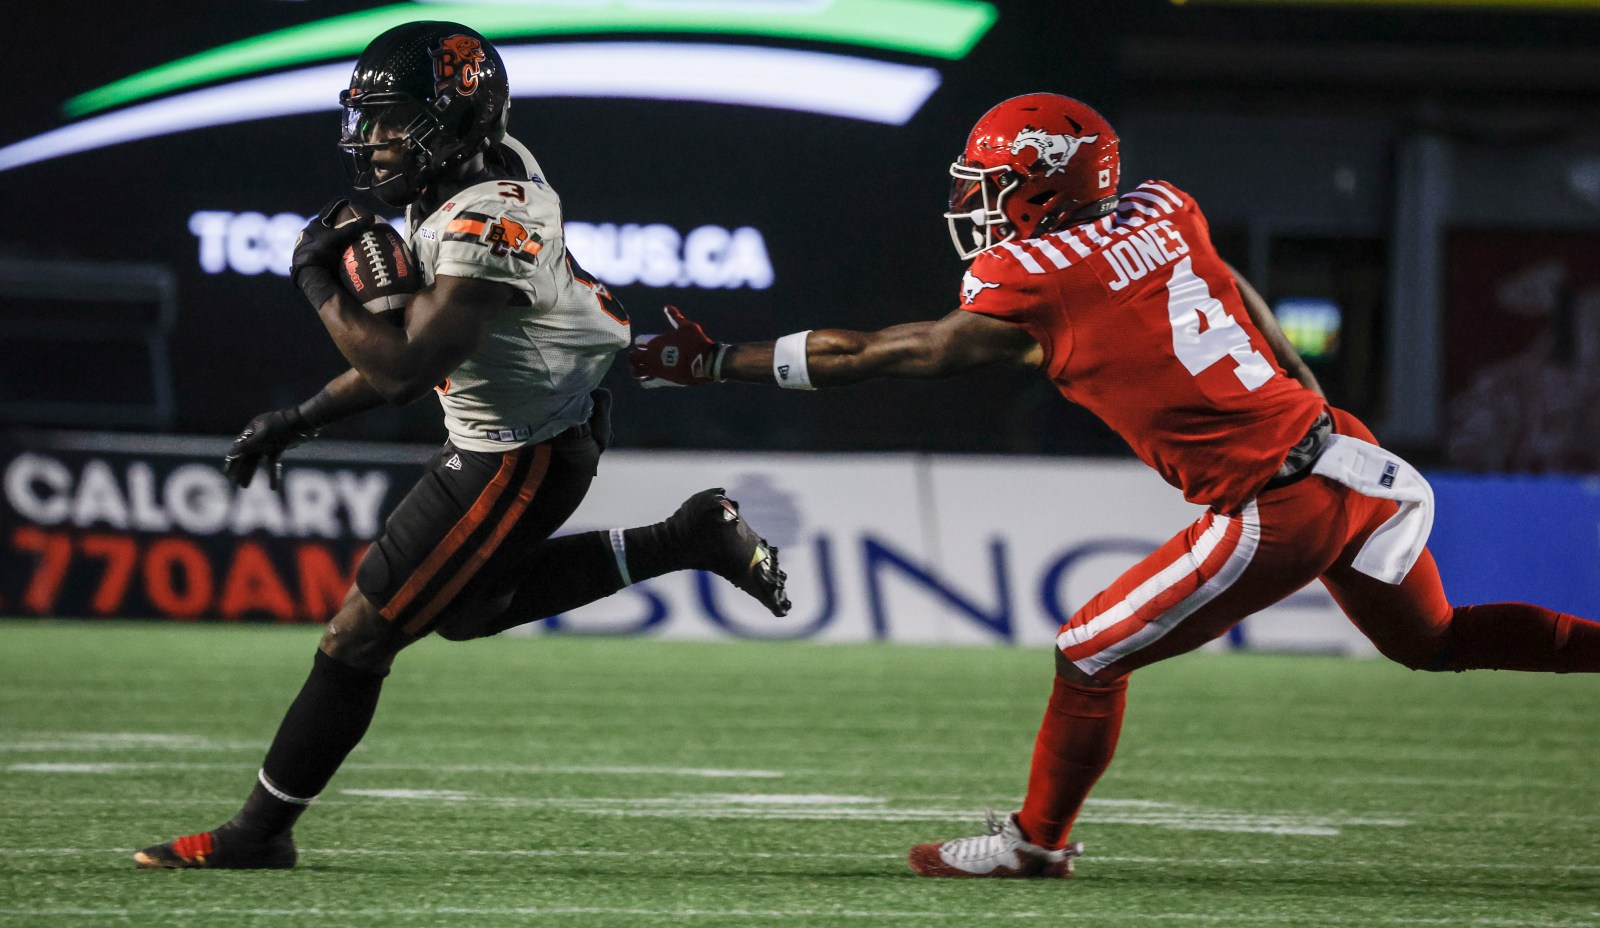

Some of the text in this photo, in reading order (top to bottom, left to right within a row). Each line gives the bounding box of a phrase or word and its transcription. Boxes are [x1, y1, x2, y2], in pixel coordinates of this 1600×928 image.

[497, 182, 526, 204] 3
[1102, 219, 1190, 291] JONES
[1165, 255, 1277, 392] 4
[3, 452, 391, 541] CALGARY
[12, 527, 372, 622] 770AM
